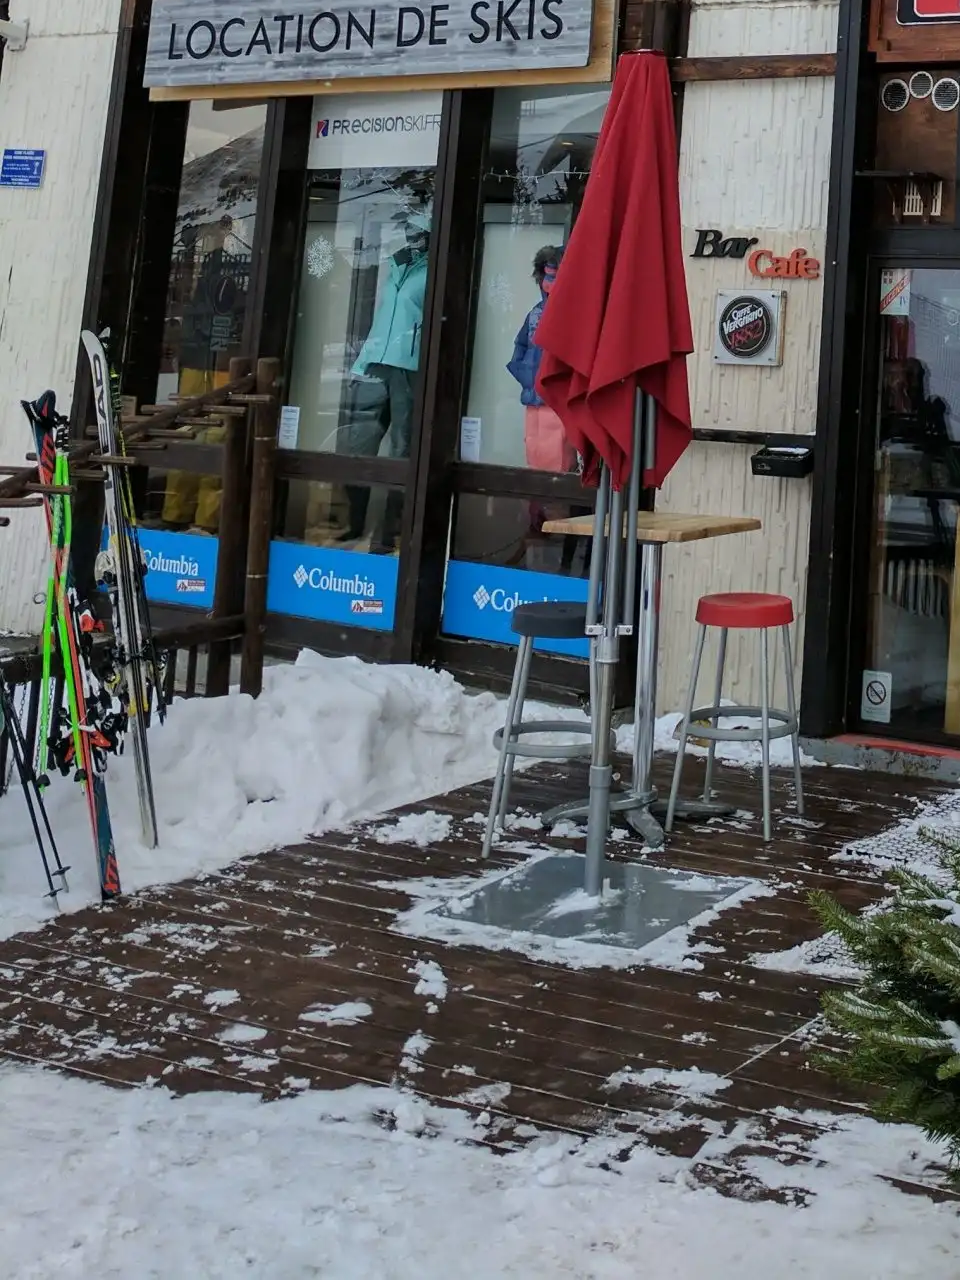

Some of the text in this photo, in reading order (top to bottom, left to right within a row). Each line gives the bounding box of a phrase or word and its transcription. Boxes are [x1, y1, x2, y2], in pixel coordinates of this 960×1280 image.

[167, 8, 376, 60] LOCATION
[396, 4, 448, 48] DE
[690, 229, 759, 259] Bar
[308, 568, 375, 597] Columbia
